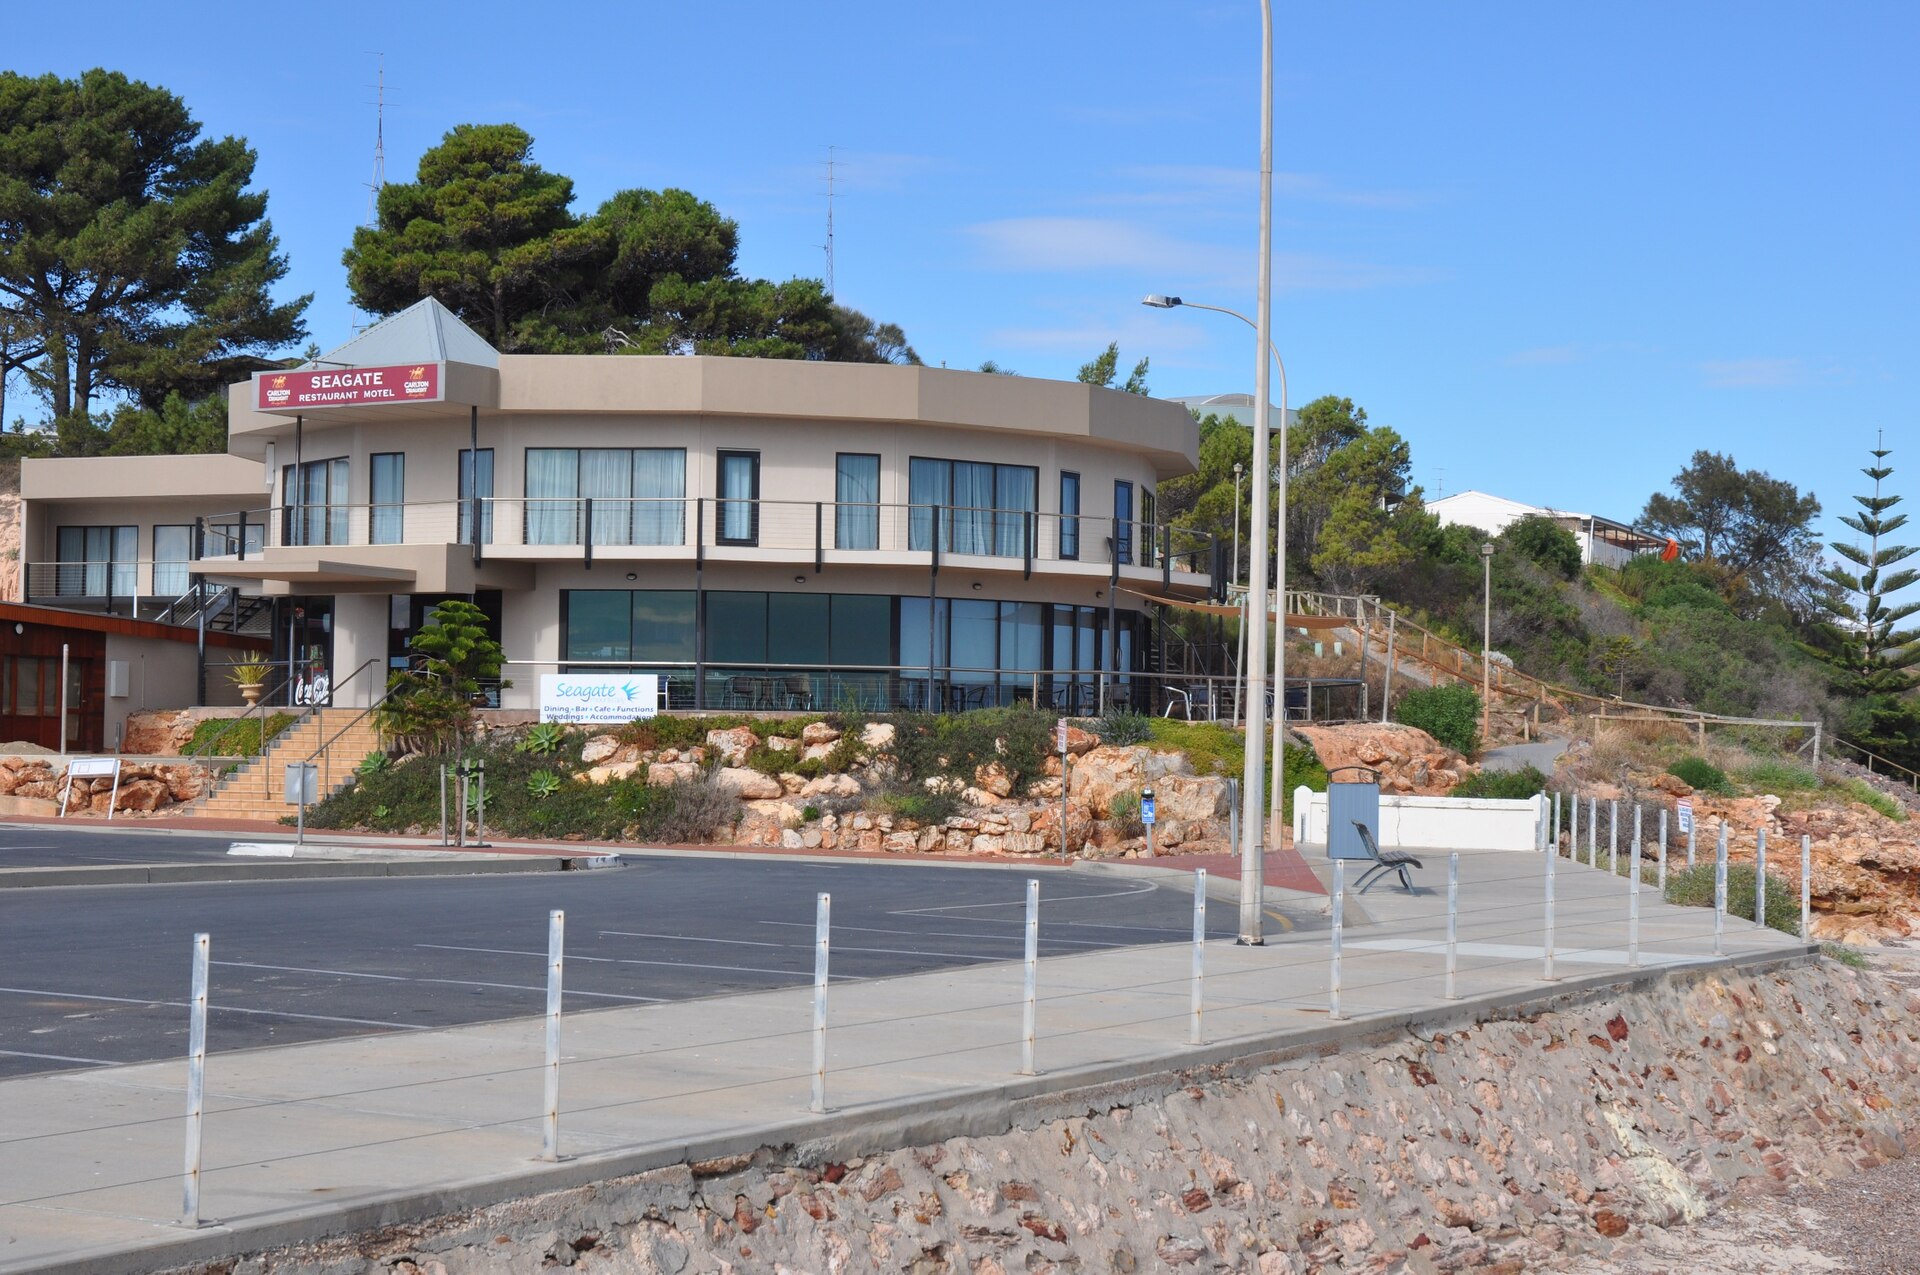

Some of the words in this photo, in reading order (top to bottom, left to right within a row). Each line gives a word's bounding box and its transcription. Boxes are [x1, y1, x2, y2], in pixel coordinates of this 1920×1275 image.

[311, 371, 383, 389] SEAGATE
[298, 391, 358, 402] RESTAURANT
[363, 388, 395, 398] MOTEL
[556, 682, 617, 703] Seagate
[543, 705, 570, 713] Dining
[616, 705, 654, 713] Functions
[546, 713, 584, 721] Weddings
